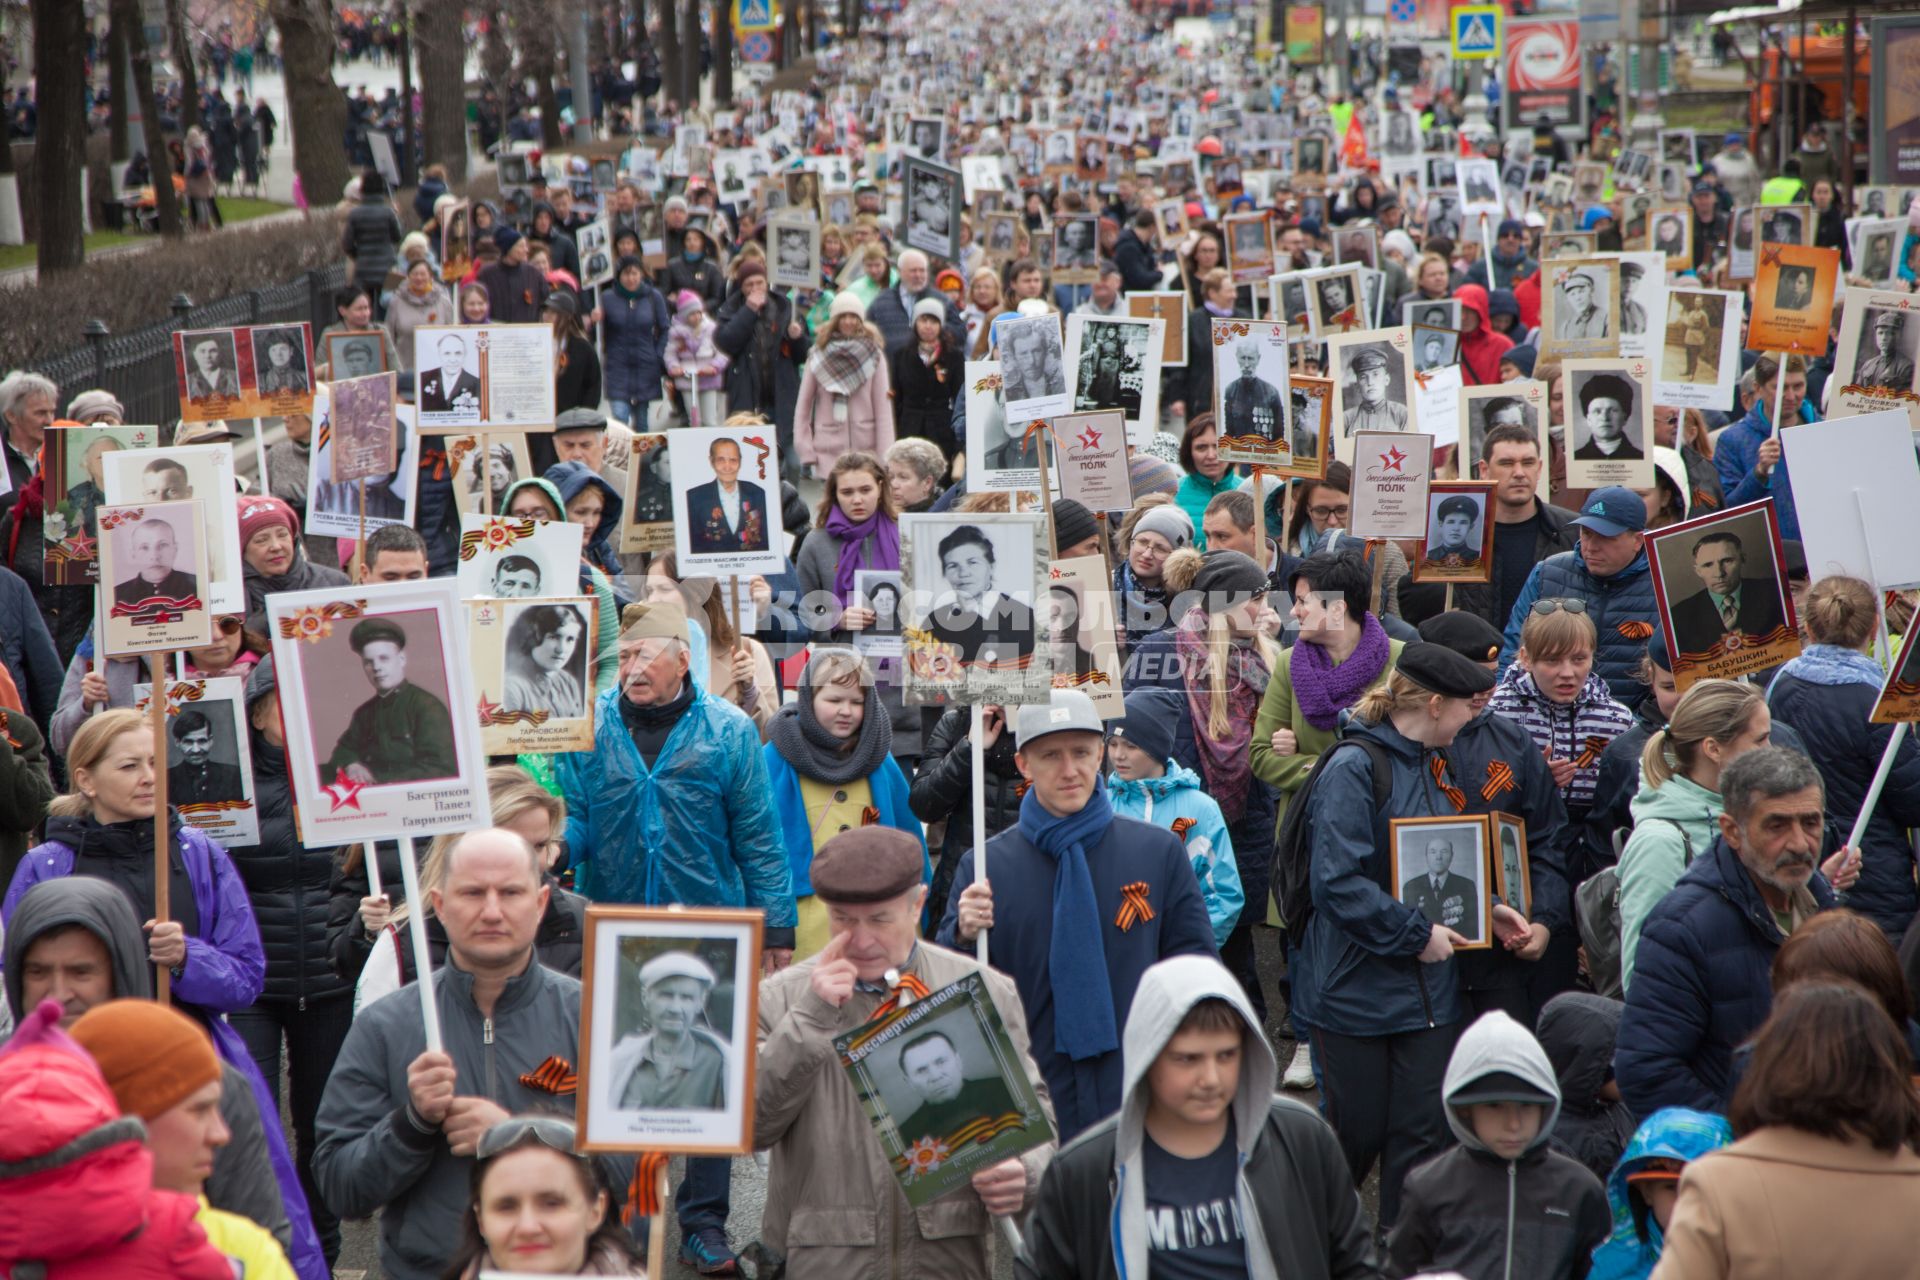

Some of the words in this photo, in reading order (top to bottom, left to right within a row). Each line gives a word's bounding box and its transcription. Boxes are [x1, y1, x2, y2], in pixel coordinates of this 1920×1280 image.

[1079, 460, 1107, 471] ПОЛК
[1376, 483, 1406, 493] ПОЛК
[1707, 648, 1768, 673] БАБУШКИН
[1723, 653, 1784, 676] Алексеевич
[519, 727, 569, 736] ТАРНОВСКАЯ
[506, 735, 535, 745] Любовь
[406, 787, 470, 802] Бастриков
[434, 800, 471, 812] Павел
[402, 812, 473, 828] Гаврилович
[847, 1000, 932, 1064] Бессмертный
[932, 981, 962, 1012] полк
